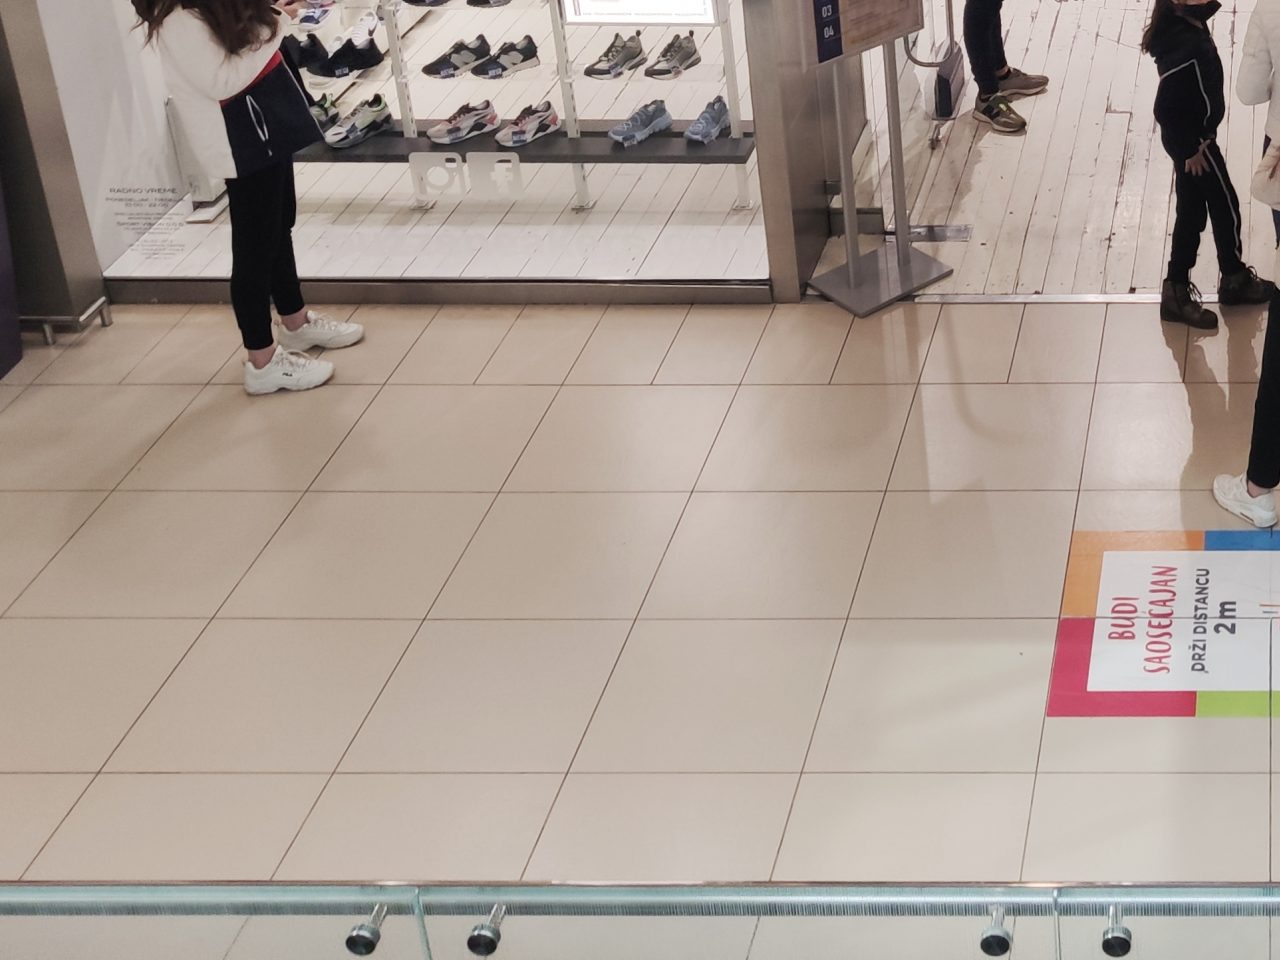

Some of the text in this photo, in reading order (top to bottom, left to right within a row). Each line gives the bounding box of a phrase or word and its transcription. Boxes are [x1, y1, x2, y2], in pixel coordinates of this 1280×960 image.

[822, 4, 833, 18] 03
[824, 25, 834, 38] 04
[1107, 597, 1140, 640] BUDI
[1188, 568, 1210, 673] DRŽI DISTANCU
